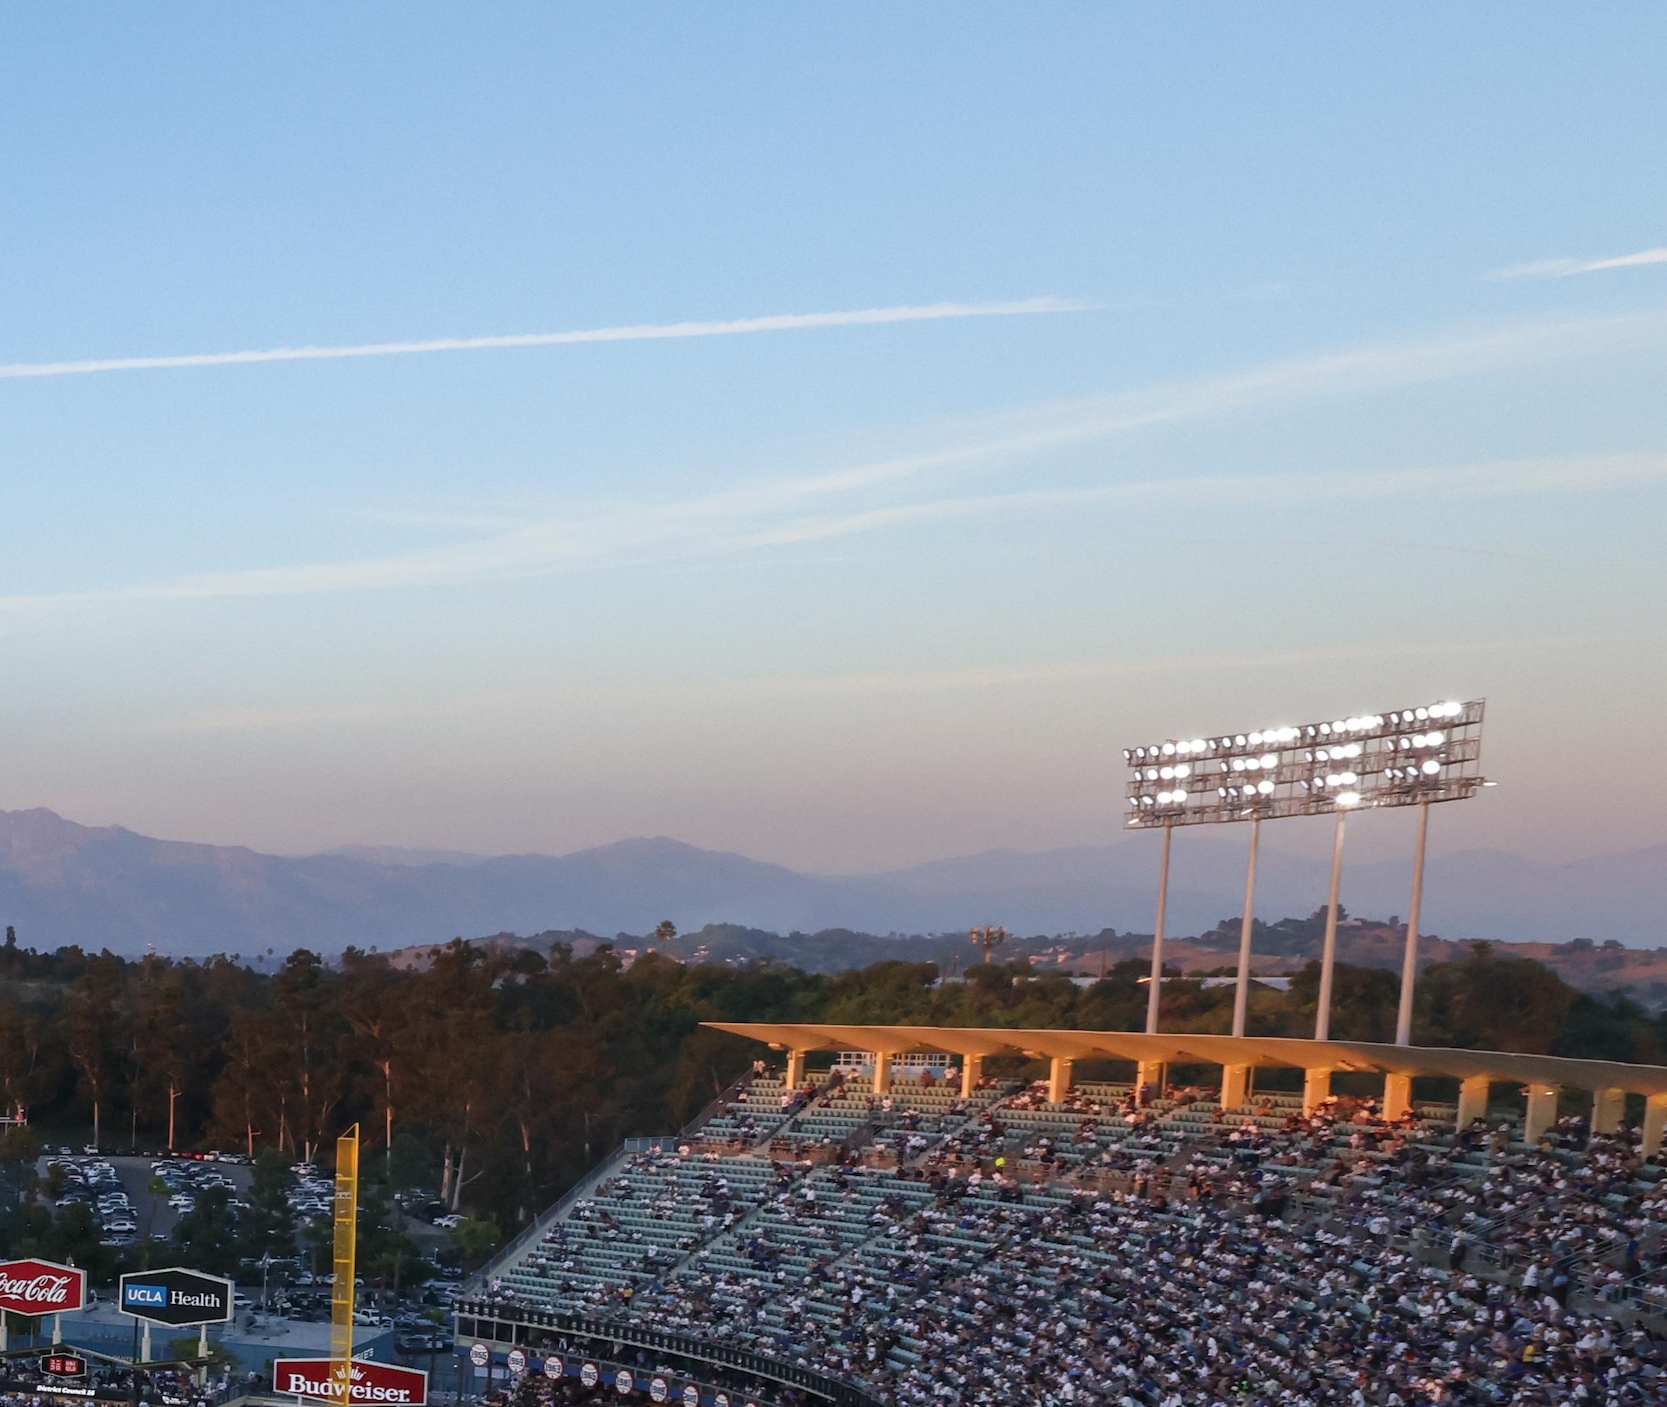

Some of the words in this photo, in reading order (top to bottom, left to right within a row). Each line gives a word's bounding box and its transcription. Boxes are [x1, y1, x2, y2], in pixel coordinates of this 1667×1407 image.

[127, 1288, 162, 1303] UCLA
[170, 1291, 221, 1308] Health
[36, 1385, 61, 1394] District
[61, 1387, 85, 1396] Council
